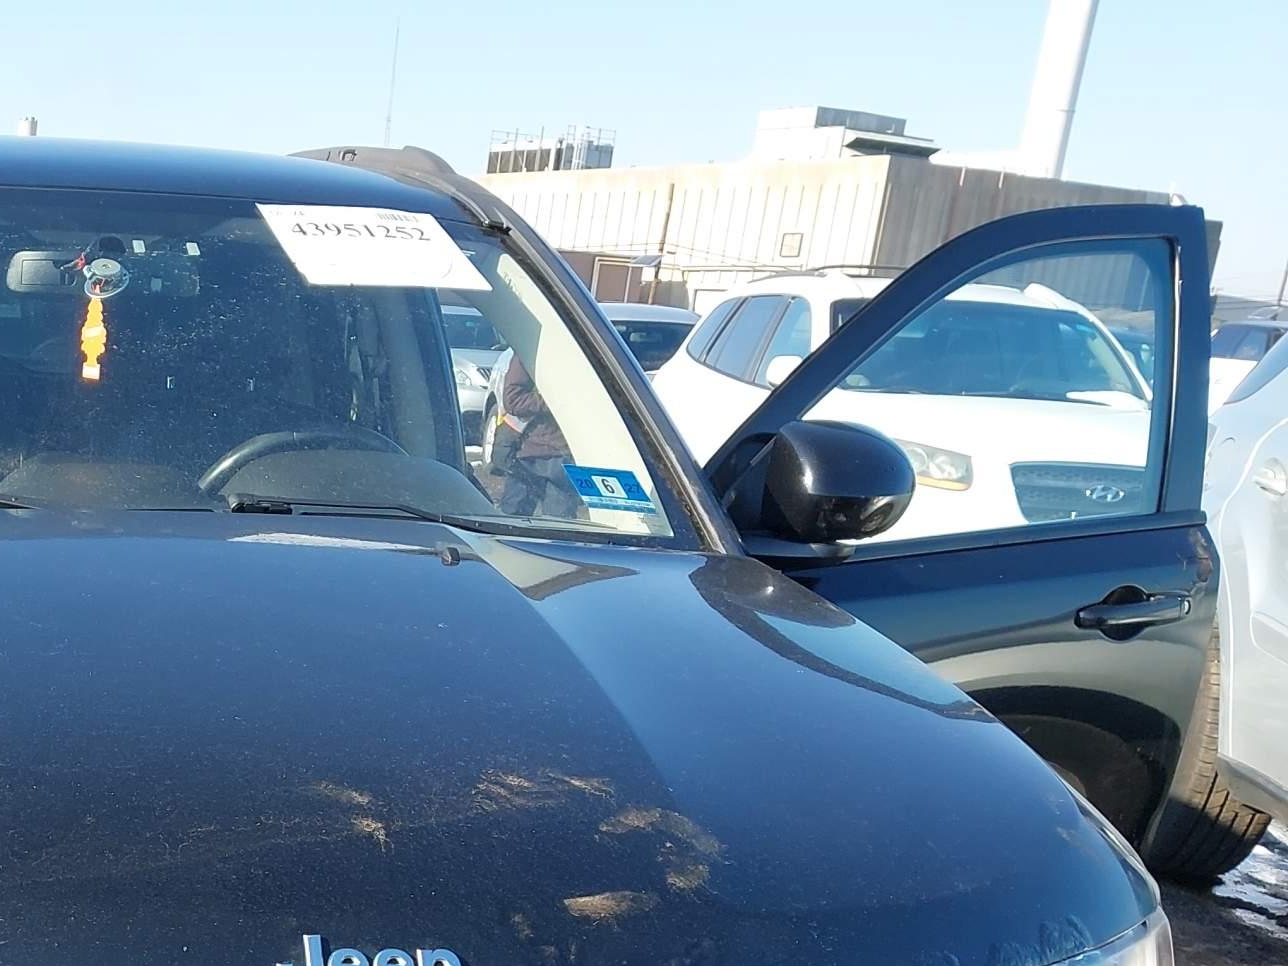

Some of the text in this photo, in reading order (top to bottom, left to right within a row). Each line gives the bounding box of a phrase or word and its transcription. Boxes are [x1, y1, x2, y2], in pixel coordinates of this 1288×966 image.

[290, 222, 432, 242] 43951252
[575, 478, 594, 489] 20
[601, 478, 616, 494] 6
